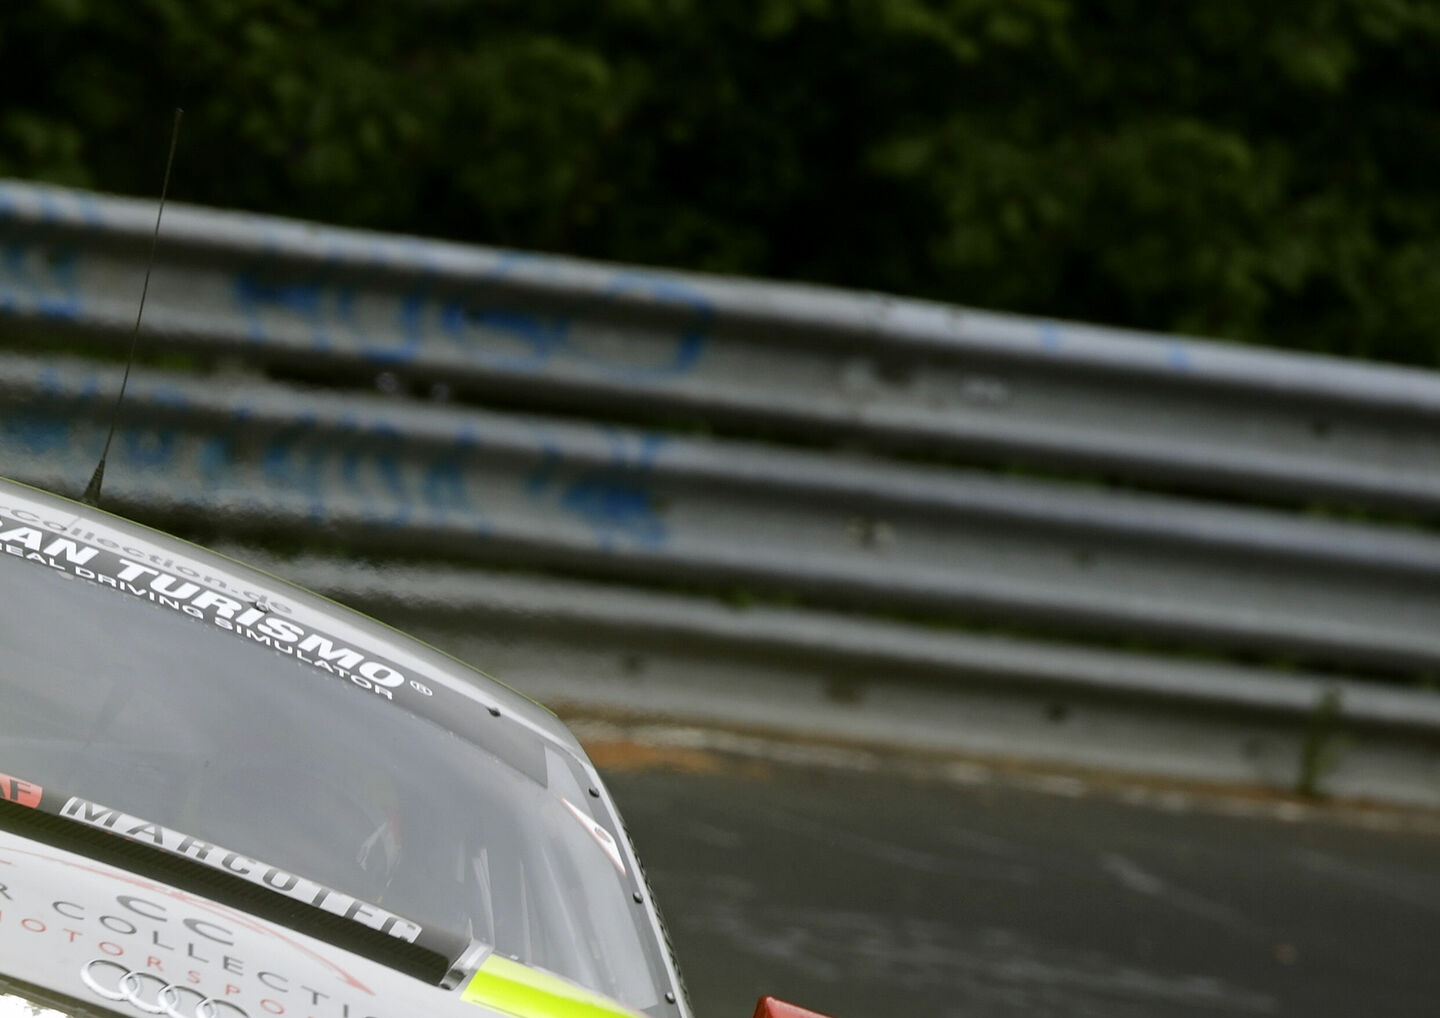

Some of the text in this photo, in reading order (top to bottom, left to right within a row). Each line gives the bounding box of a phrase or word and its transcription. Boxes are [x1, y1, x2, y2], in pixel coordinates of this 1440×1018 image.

[75, 566, 204, 619] DRIVING
[214, 617, 394, 700] SIMULATOR
[118, 559, 406, 688] TURISMO
